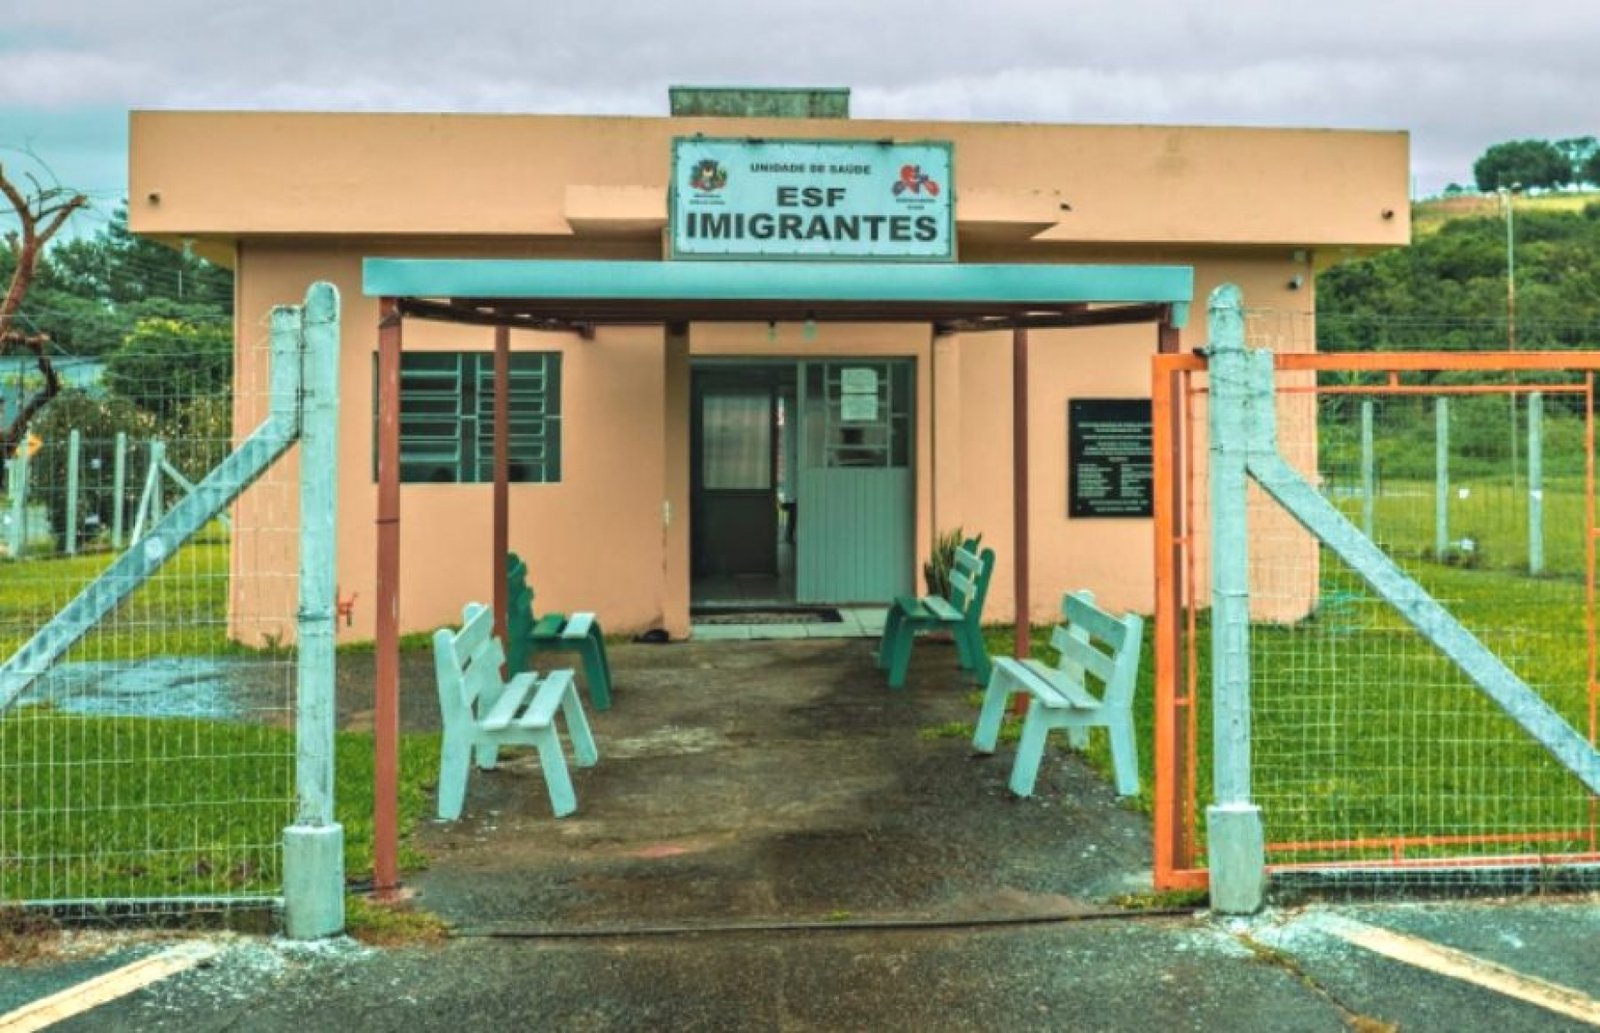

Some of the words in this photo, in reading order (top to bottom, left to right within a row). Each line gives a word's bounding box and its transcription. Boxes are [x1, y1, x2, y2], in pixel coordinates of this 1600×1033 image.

[750, 163, 805, 174] UNIDADE
[810, 164, 826, 174] DE
[829, 162, 872, 175] SAÚDE
[776, 186, 847, 208] ESF
[686, 212, 939, 242] IMIGRANTES
